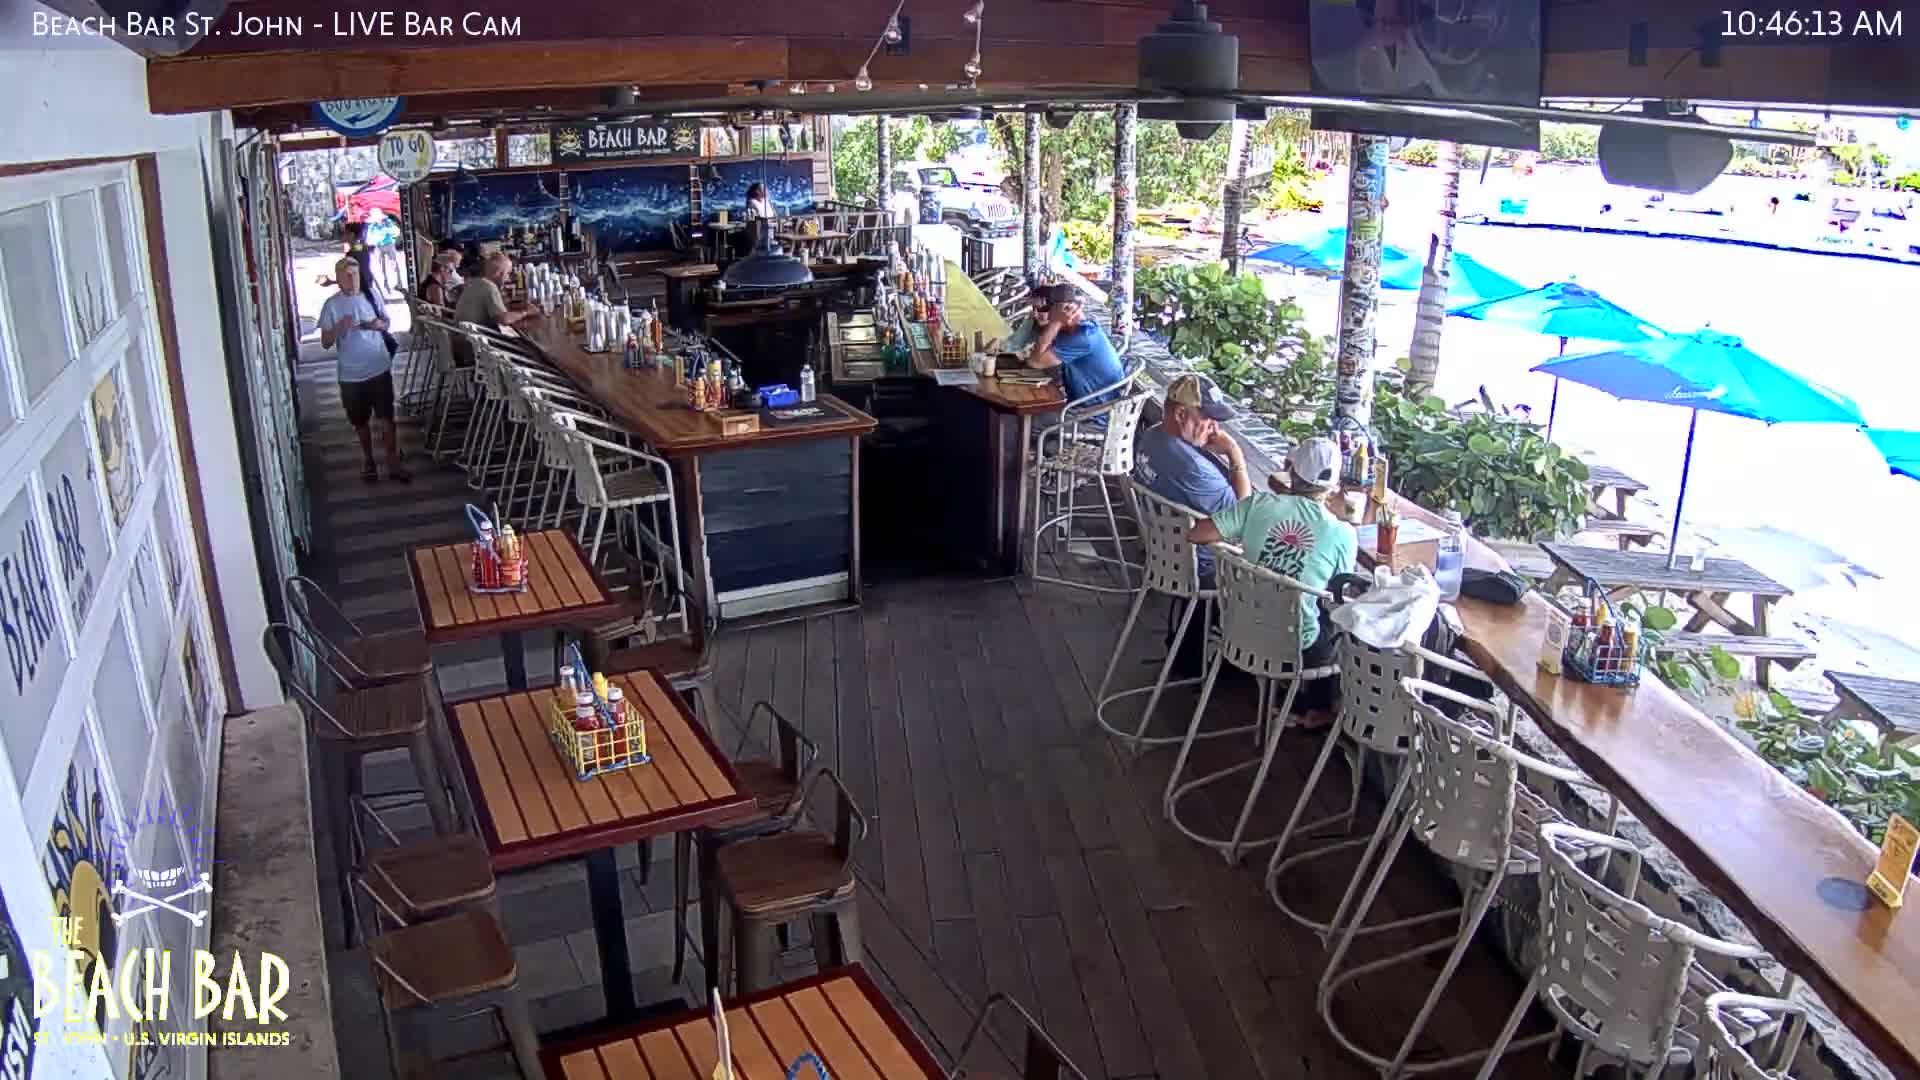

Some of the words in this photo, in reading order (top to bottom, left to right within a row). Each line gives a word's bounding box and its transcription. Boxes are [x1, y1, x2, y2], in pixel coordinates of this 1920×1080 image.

[386, 135, 404, 157] TO
[409, 133, 425, 153] GO
[588, 128, 632, 149] BEACH
[637, 127, 668, 147] BAR
[0, 517, 58, 697] BEACH
